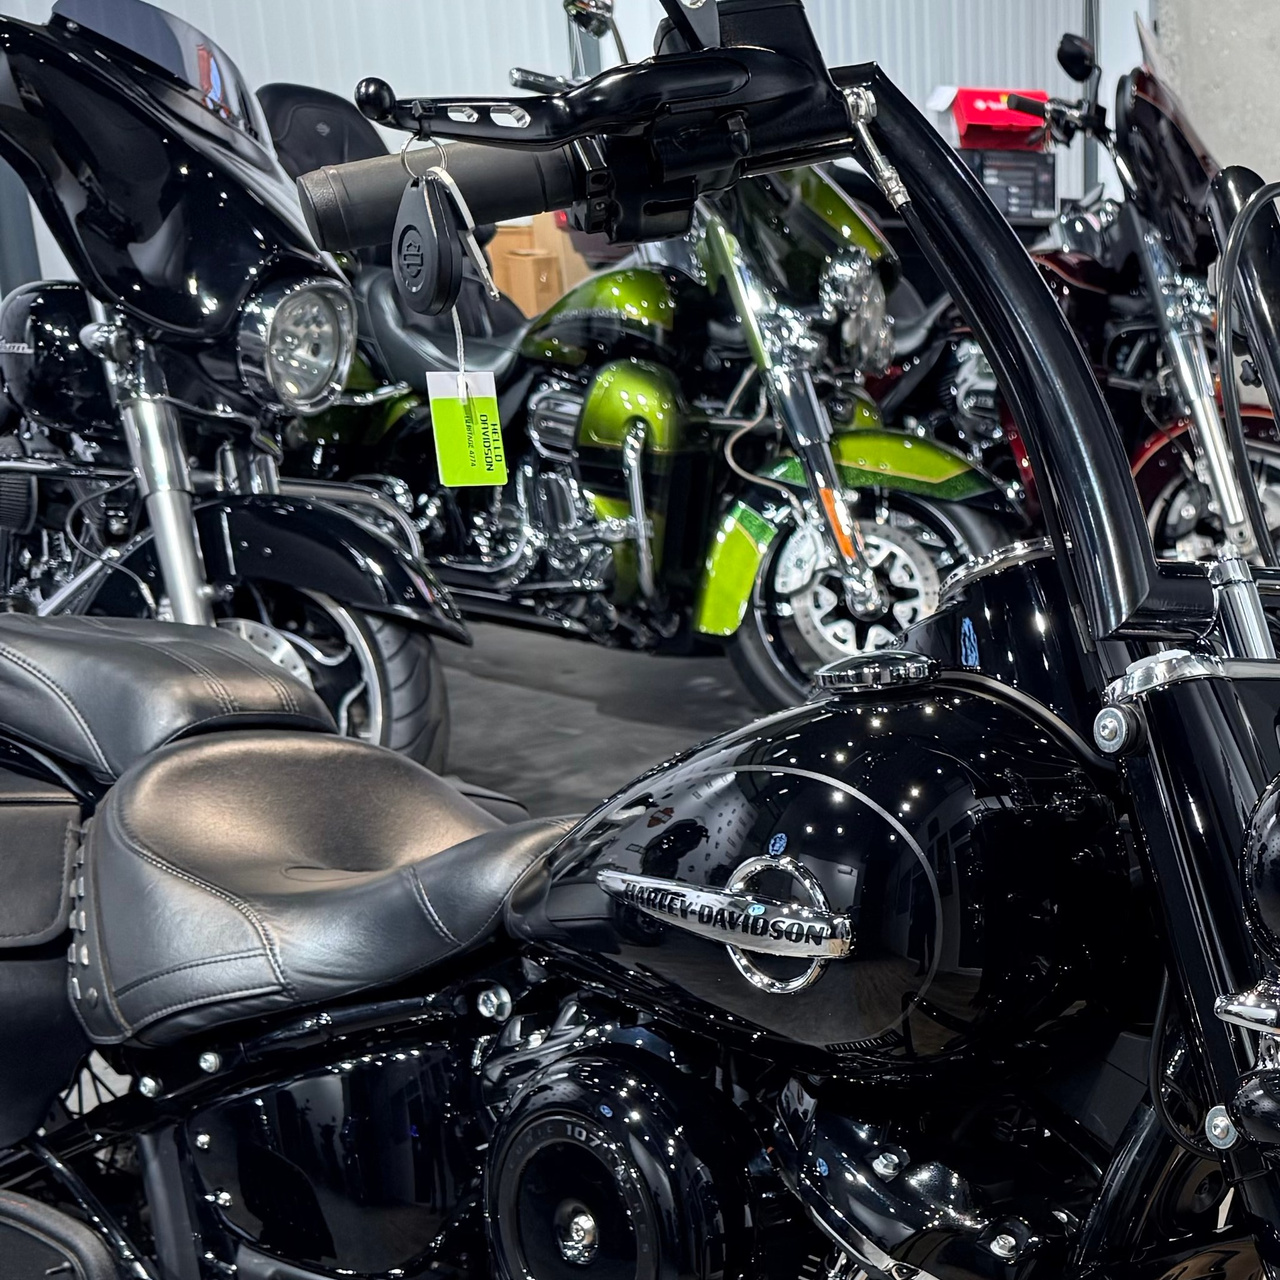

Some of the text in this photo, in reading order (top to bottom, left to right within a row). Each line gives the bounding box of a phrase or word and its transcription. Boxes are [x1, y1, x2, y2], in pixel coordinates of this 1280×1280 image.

[468, 450, 477, 467] 4774
[479, 414, 495, 472] DAVIDSON
[490, 422, 503, 463] HELLO
[624, 881, 829, 945] HARLEY-DAVIDSON
[566, 1124, 601, 1147] 107
